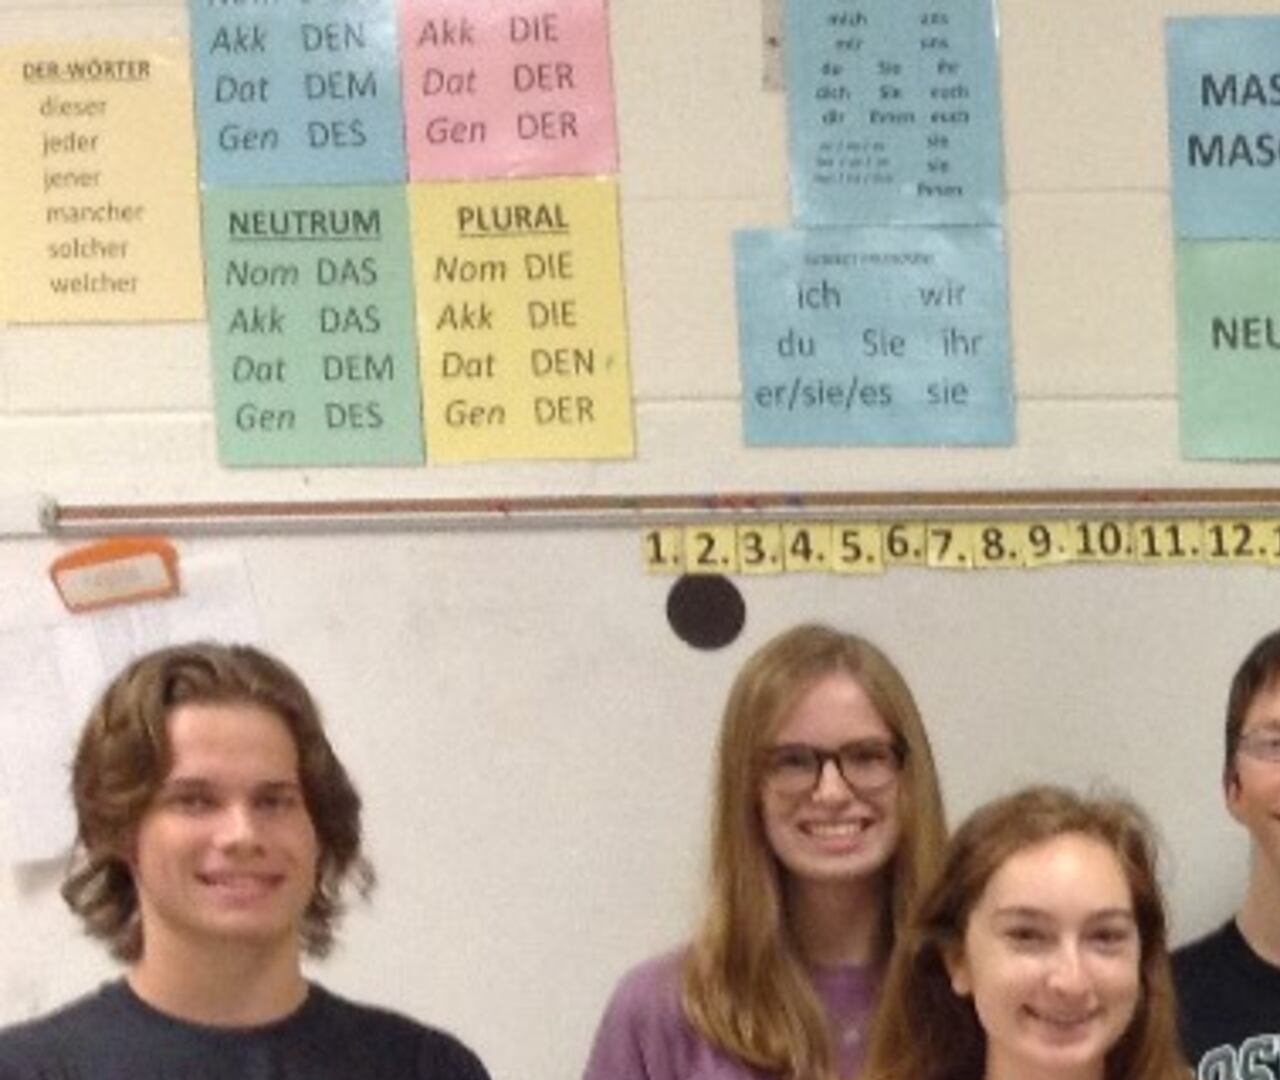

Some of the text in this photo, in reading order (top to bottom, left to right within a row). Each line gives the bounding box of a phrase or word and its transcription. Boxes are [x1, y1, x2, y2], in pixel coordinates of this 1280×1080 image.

[211, 23, 364, 53] Akk DEN
[418, 14, 558, 47] Akk DIE
[216, 72, 377, 103] Dat DEM
[422, 65, 574, 96] Dat DER
[40, 96, 106, 116] dieser
[43, 131, 98, 155] jeder
[219, 122, 366, 151] Gen DES
[426, 112, 578, 145] Gen DER
[44, 170, 100, 191] jener
[47, 202, 144, 223] mancher
[229, 210, 381, 235] NEUTRUM
[458, 204, 568, 231] PLURAL
[49, 238, 127, 259] solcher
[50, 273, 138, 294] welcher
[226, 258, 377, 287] Nom DAS
[434, 254, 573, 284] Nom DIE
[798, 280, 966, 310] ich wir
[228, 306, 380, 334] Akk DAS
[437, 302, 577, 331] Akk DIE
[778, 324, 983, 357] du Sie ihr
[232, 355, 394, 383] Dat DEM
[441, 349, 594, 379] Dat DEN
[756, 376, 969, 411] er/sie/es sie
[235, 403, 384, 433] Gen DES
[445, 397, 595, 427] Gen DER
[648, 534, 678, 565] 1.
[696, 532, 729, 565] 2.
[743, 531, 778, 564] 3.
[790, 530, 825, 562] 4.
[841, 530, 874, 563] 5.
[887, 524, 921, 557] 6.
[931, 528, 966, 562] 7.
[982, 527, 1017, 560] 8.
[1029, 524, 1064, 557] 9.
[1077, 522, 1133, 556] 10.
[1140, 525, 1198, 557] 11.
[1208, 524, 1267, 557] 12.
